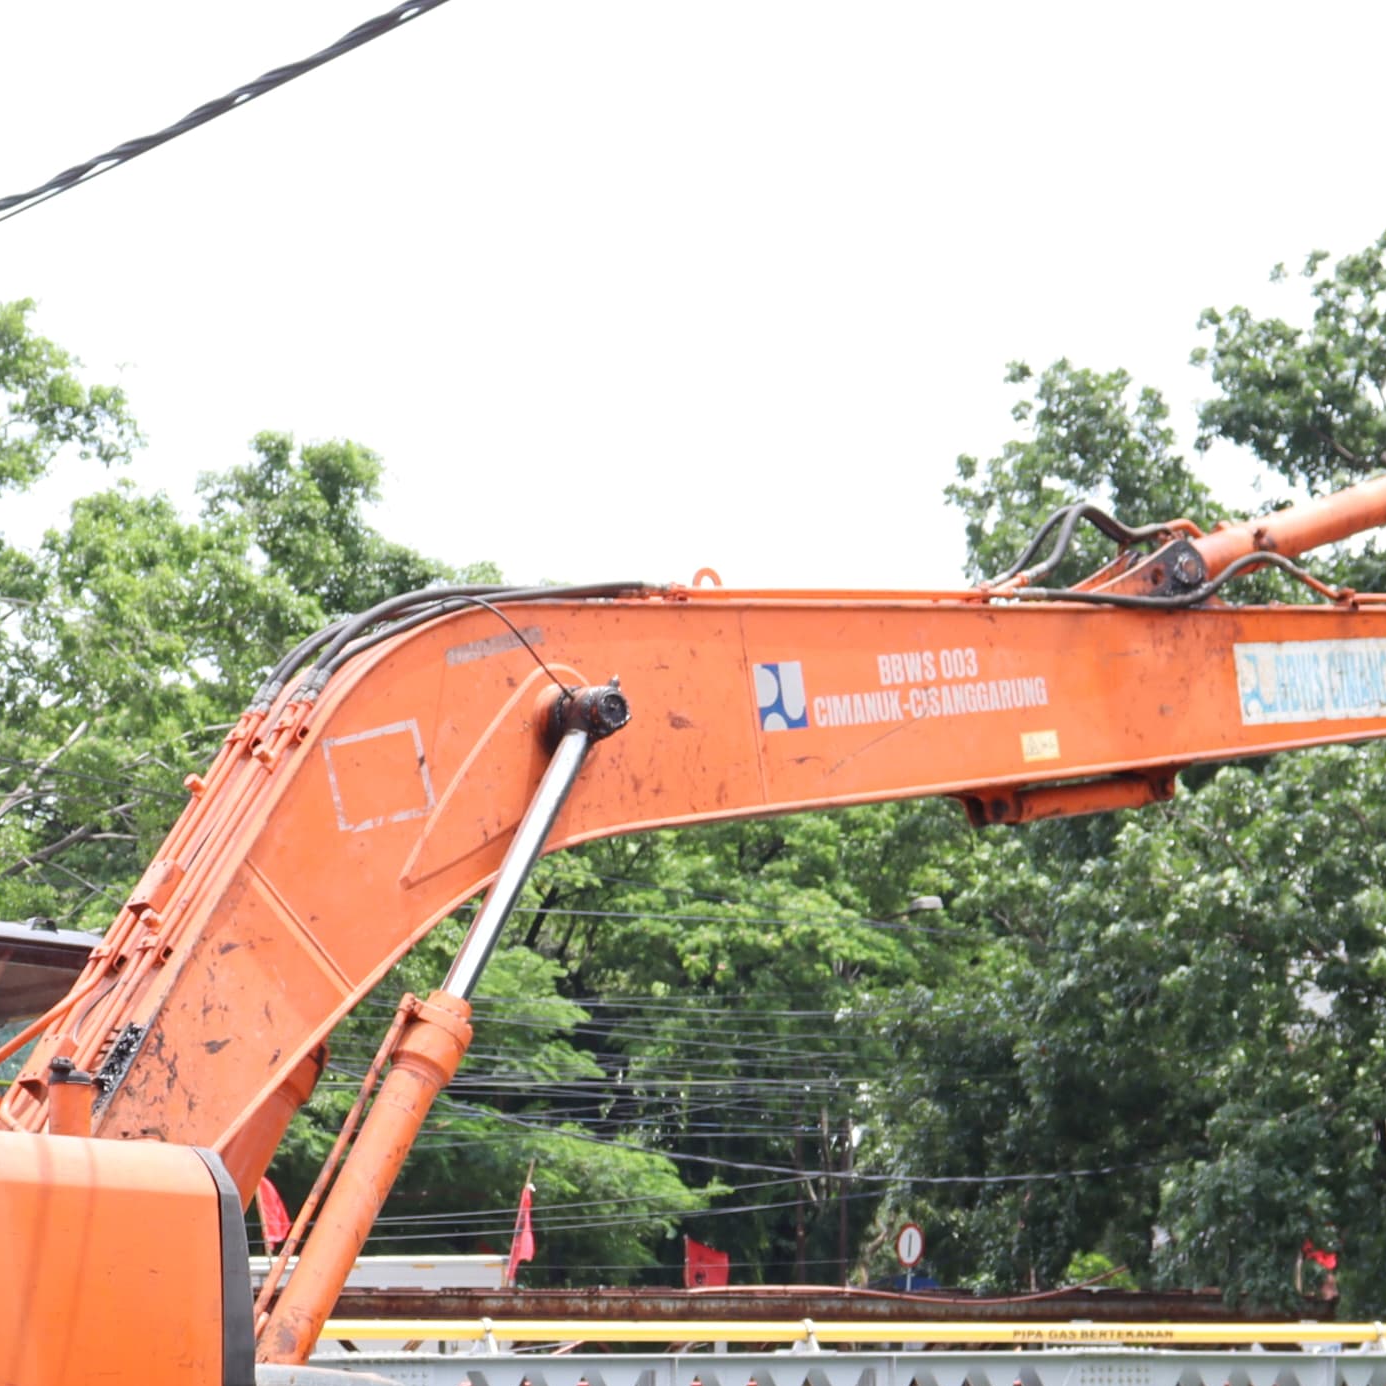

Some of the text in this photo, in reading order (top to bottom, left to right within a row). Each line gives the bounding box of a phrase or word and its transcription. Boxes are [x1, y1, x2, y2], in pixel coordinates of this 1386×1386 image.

[877, 647, 979, 686] BBWS 003
[813, 676, 1049, 727] CIMANUK-CISANGGARUNG
[1013, 1330, 1174, 1339] PIPA GAS BERTEKANAN
